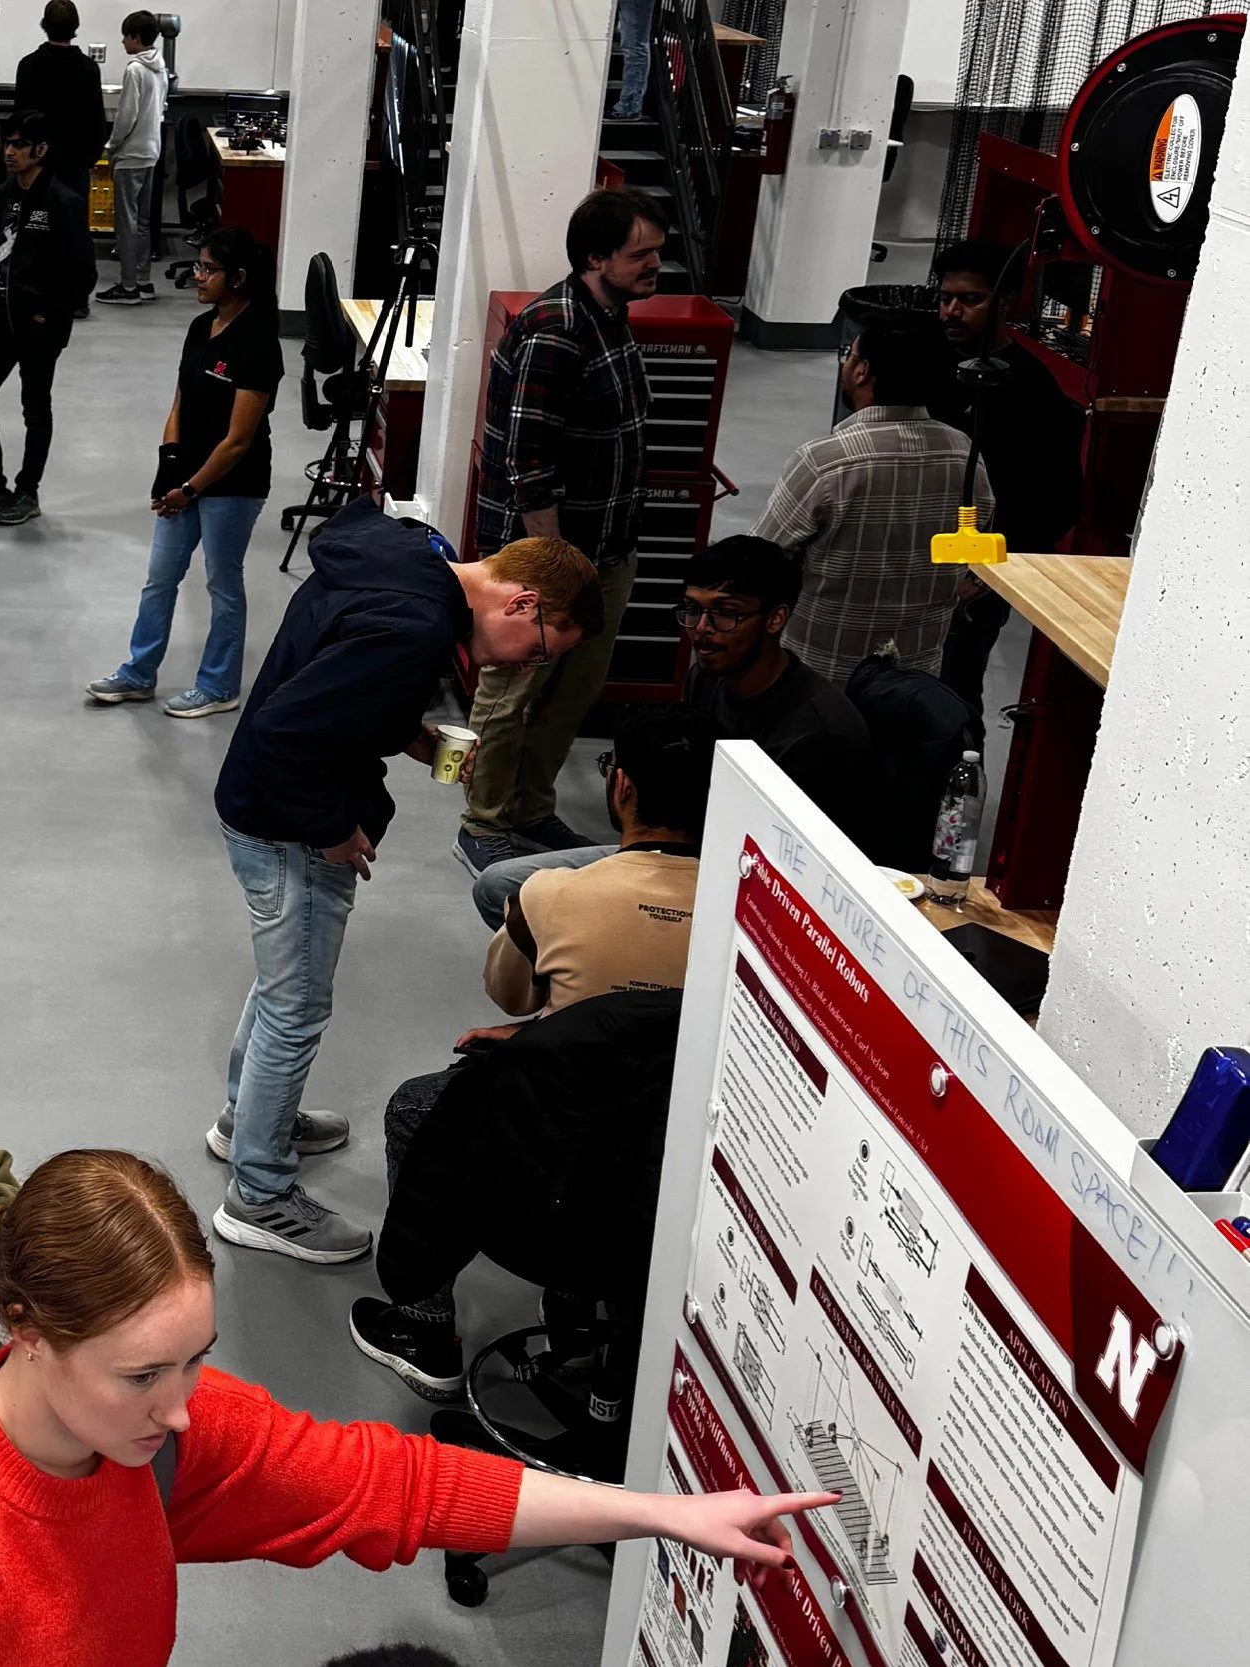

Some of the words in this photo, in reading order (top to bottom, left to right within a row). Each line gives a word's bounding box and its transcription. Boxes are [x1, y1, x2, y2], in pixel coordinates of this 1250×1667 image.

[1154, 138, 1168, 170] WARNING
[1164, 152, 1173, 180] ELECTRIC
[1169, 115, 1179, 150] COLLECTOR
[1176, 158, 1184, 181] POWER
[1180, 135, 1189, 157] BEFORE
[1184, 149, 1192, 181] REMOVING
[1188, 128, 1196, 148] COVER
[639, 904, 693, 917] PROTECTION
[771, 879, 801, 922] Driven
[801, 913, 837, 963] Parallel
[836, 954, 869, 1002] Robots
[758, 989, 800, 1052] BACKGROUND
[772, 824, 806, 875] THE
[821, 874, 885, 966] FUTURE
[903, 970, 930, 1008] OF
[941, 1003, 990, 1077] THIS
[1004, 1075, 1060, 1162] ROOM
[854, 1033, 870, 1055] Carl
[870, 1050, 890, 1080] Nelson
[832, 1307, 861, 1357] SYSTEM
[861, 1354, 915, 1444] ARCHITECTURE
[968, 1301, 987, 1335] Where
[986, 1332, 999, 1349] our
[998, 1346, 1019, 1379] CDPR
[1018, 1377, 1037, 1404] could
[1036, 1398, 1046, 1417] be
[1045, 1414, 1064, 1442] used:
[1007, 1330, 1069, 1417] APPLICATION
[1095, 1306, 1156, 1420] N
[707, 1412, 736, 1475] Stiffness
[963, 1522, 998, 1583] FUTURE
[1001, 1578, 1029, 1630] WORK
[802, 1596, 832, 1659] Driven
